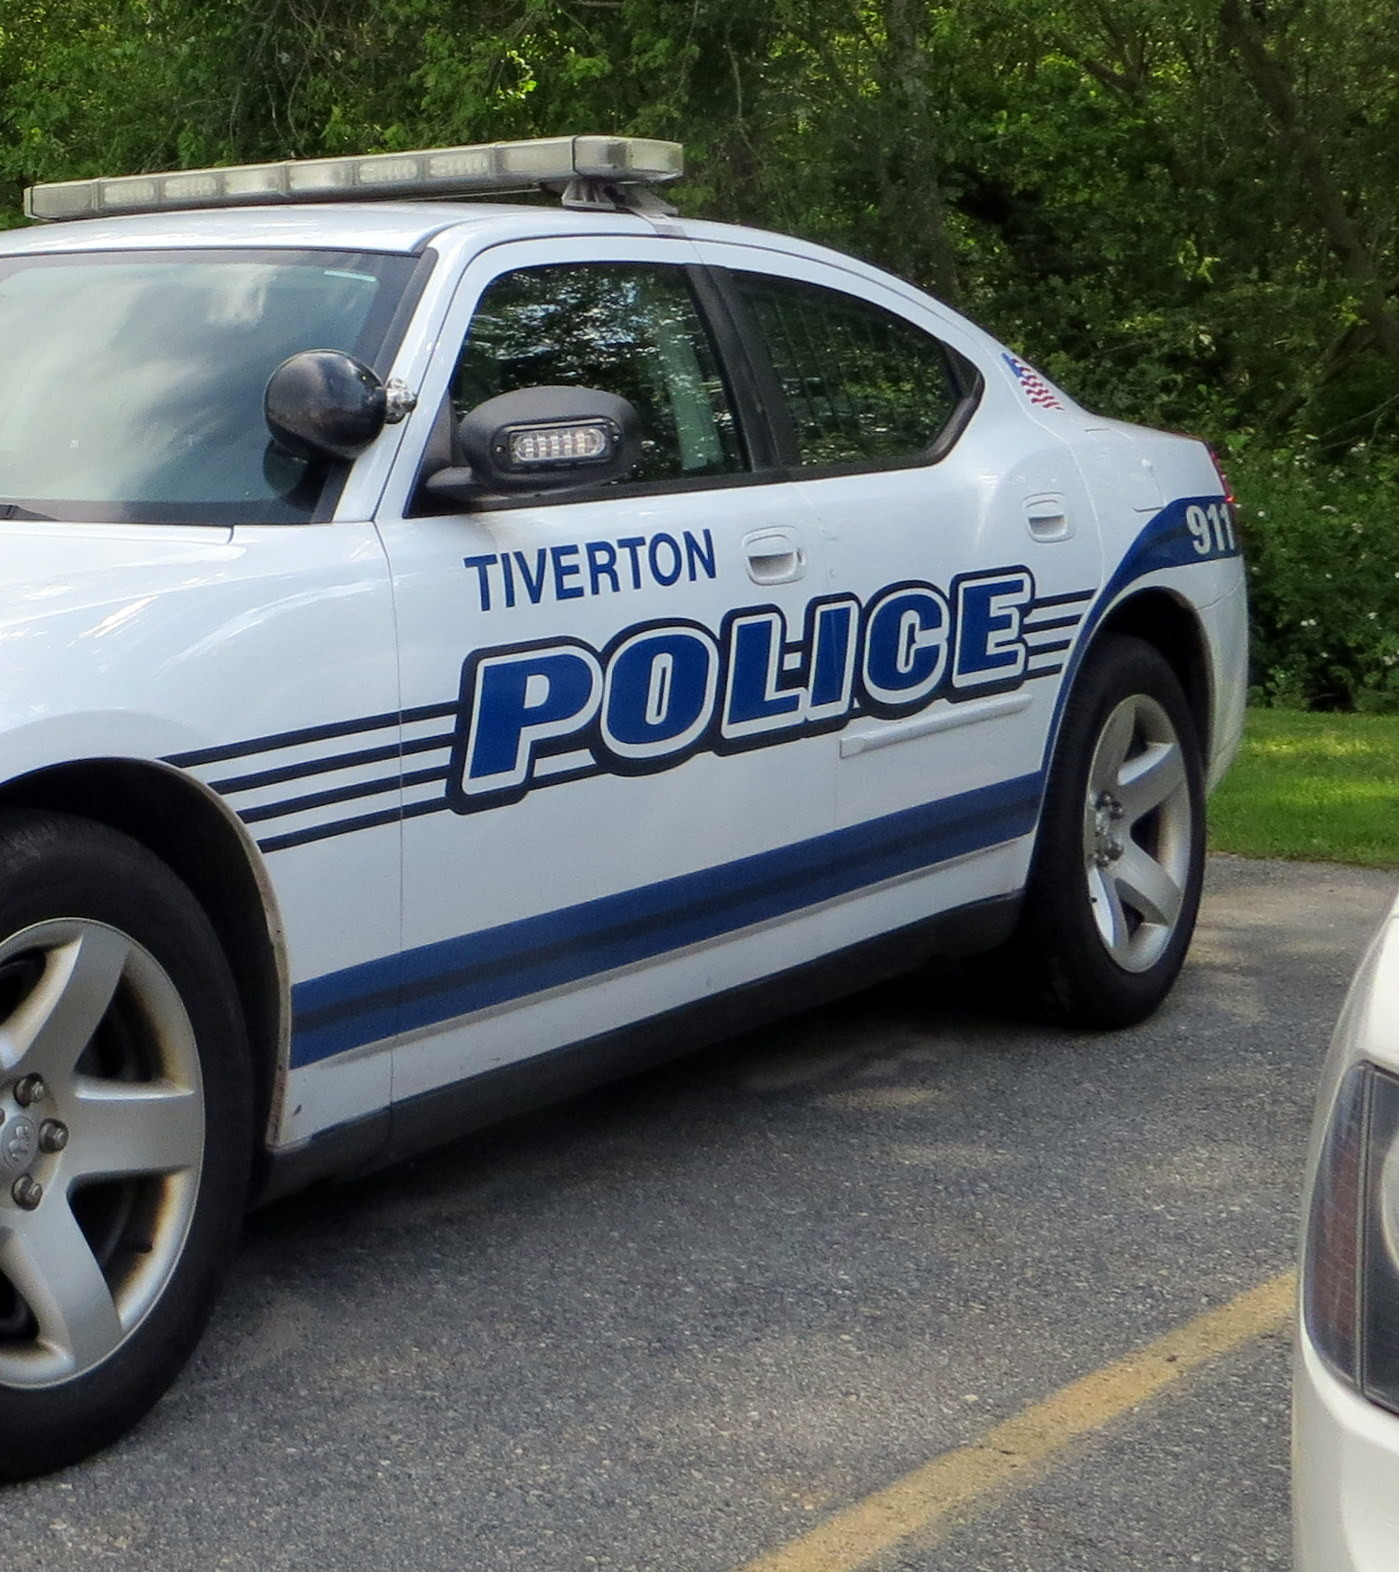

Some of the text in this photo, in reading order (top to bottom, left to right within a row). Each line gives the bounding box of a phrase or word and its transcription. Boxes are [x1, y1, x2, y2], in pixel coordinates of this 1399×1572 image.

[463, 528, 717, 612] TIVERTON
[1186, 503, 1236, 555] 911
[455, 565, 1036, 815] POLICE
